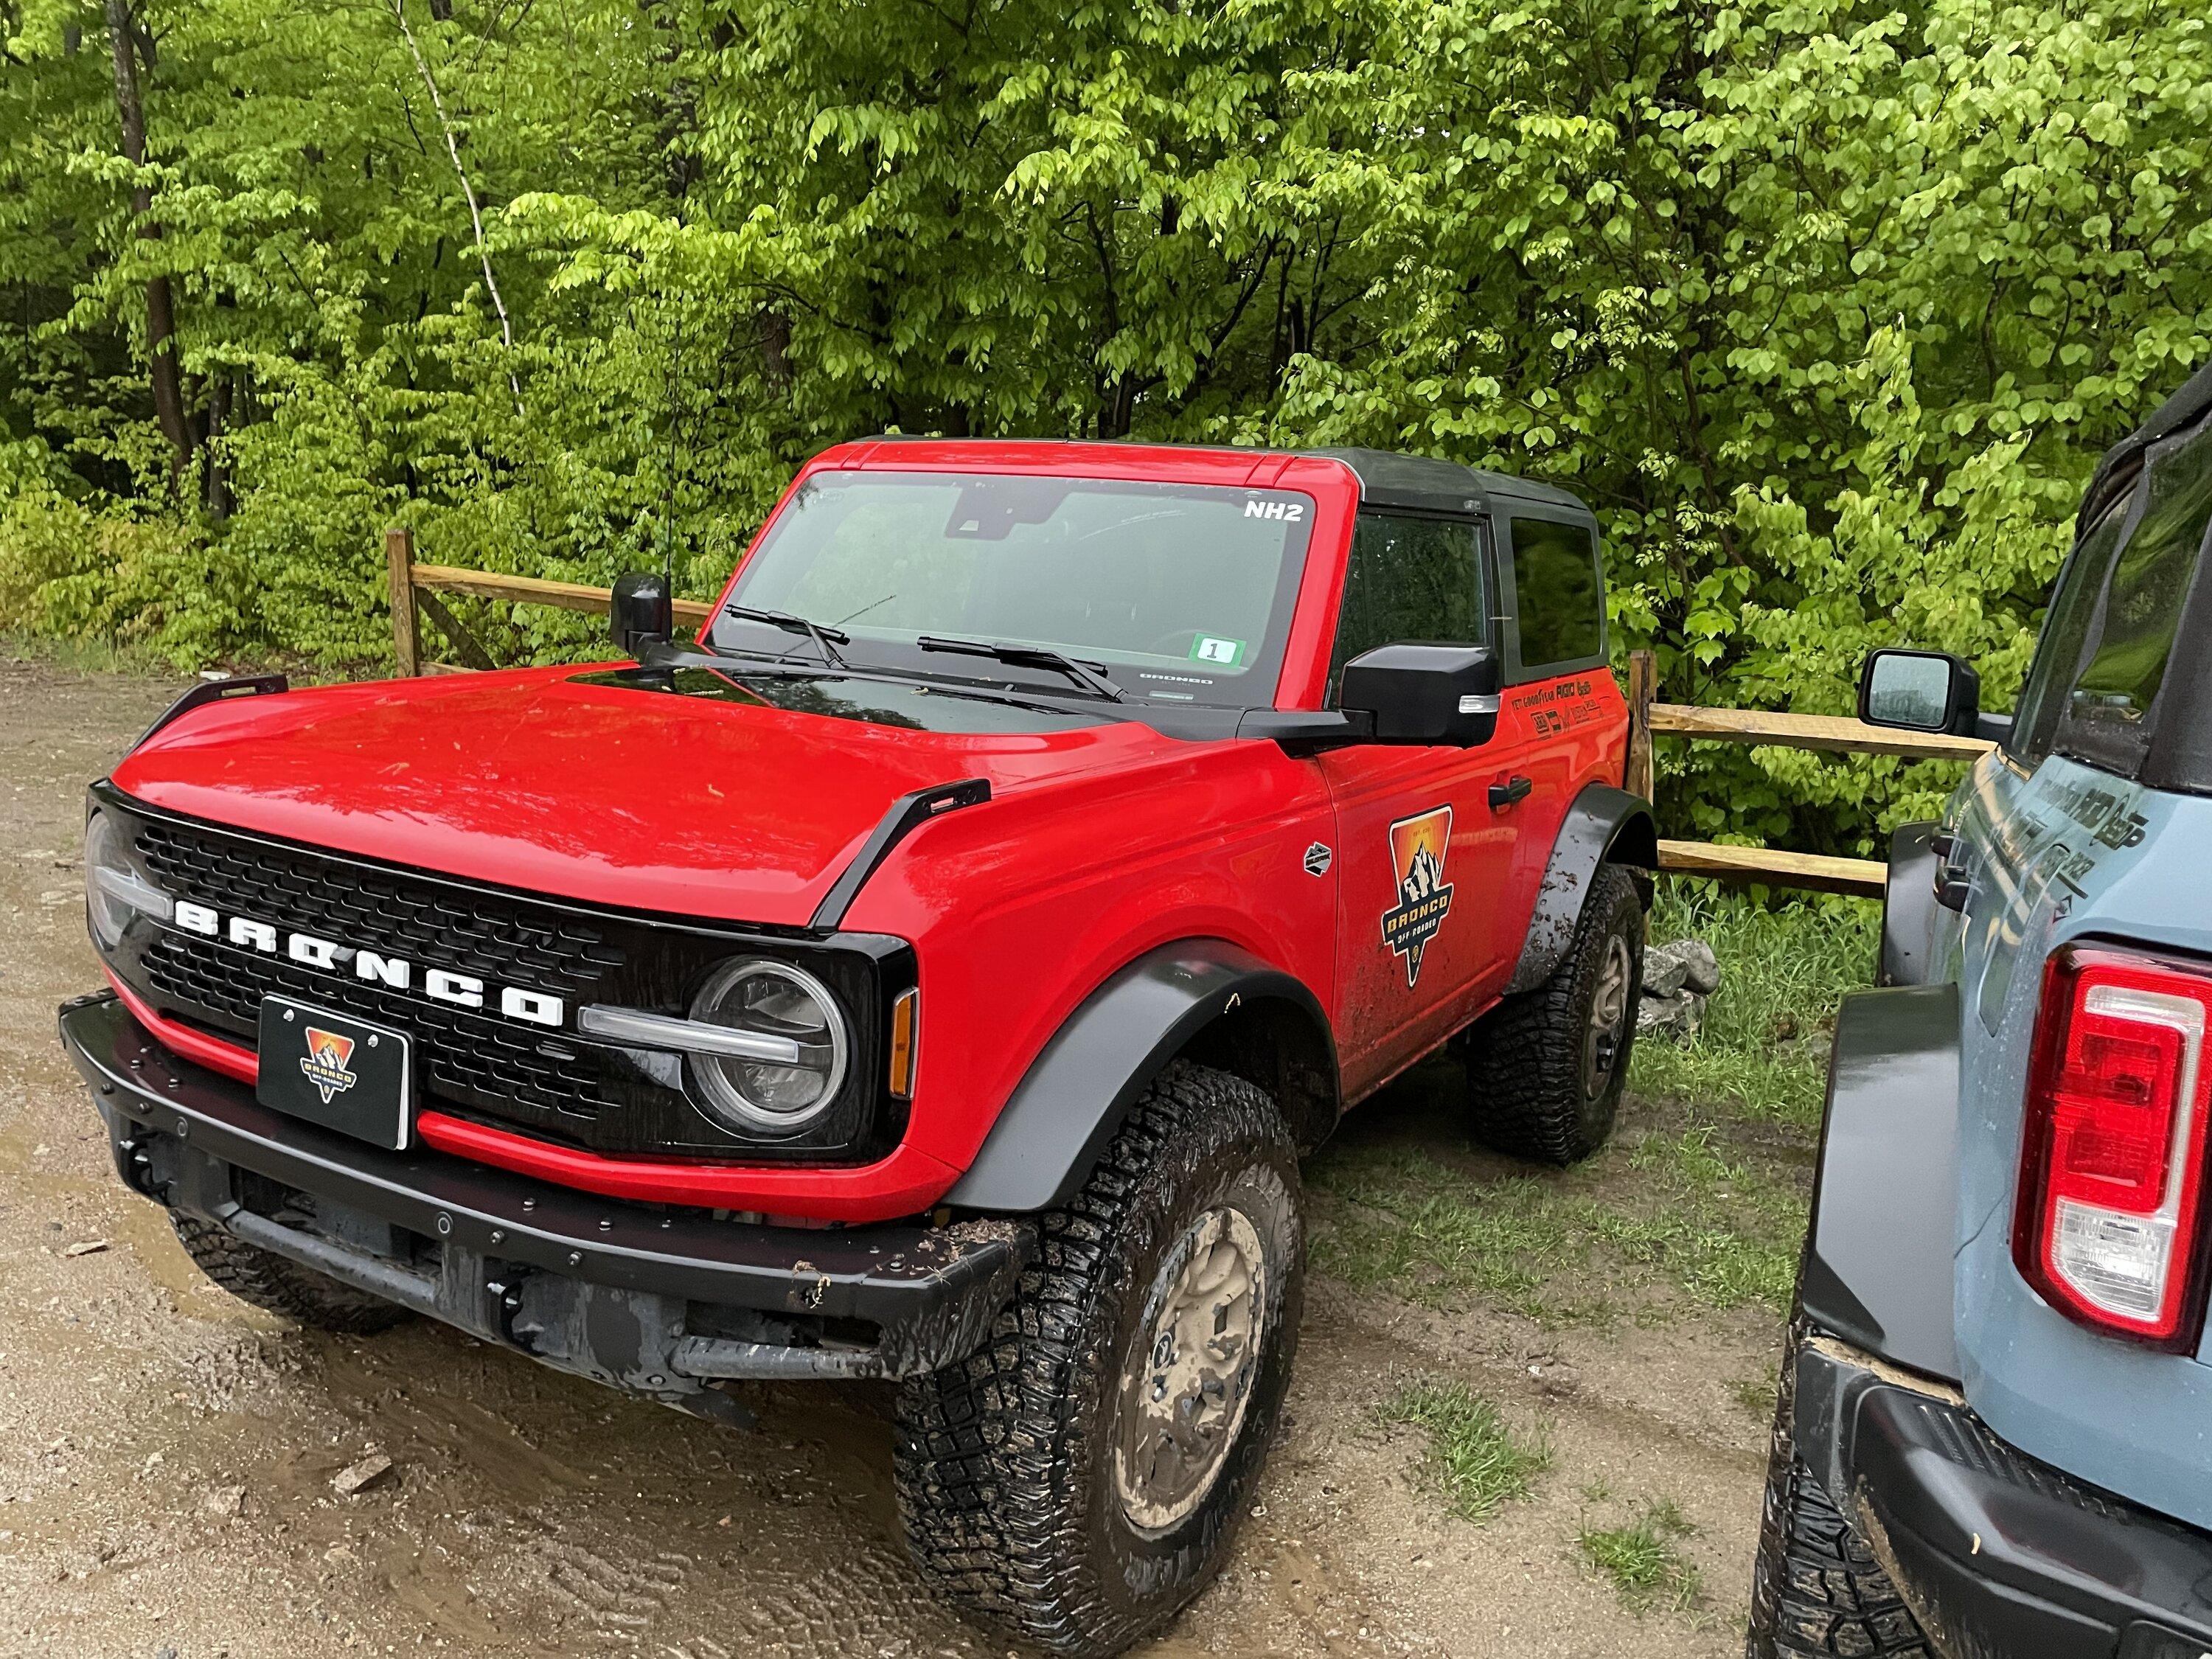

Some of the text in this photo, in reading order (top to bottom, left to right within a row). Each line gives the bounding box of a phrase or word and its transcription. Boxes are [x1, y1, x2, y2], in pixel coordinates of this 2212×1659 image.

[1244, 501, 1304, 522] NH2
[1206, 643, 1218, 659] 1
[1387, 894, 1448, 934] BRONCO
[175, 900, 563, 1027] BRONCO
[304, 1062, 352, 1083] BRONCO
